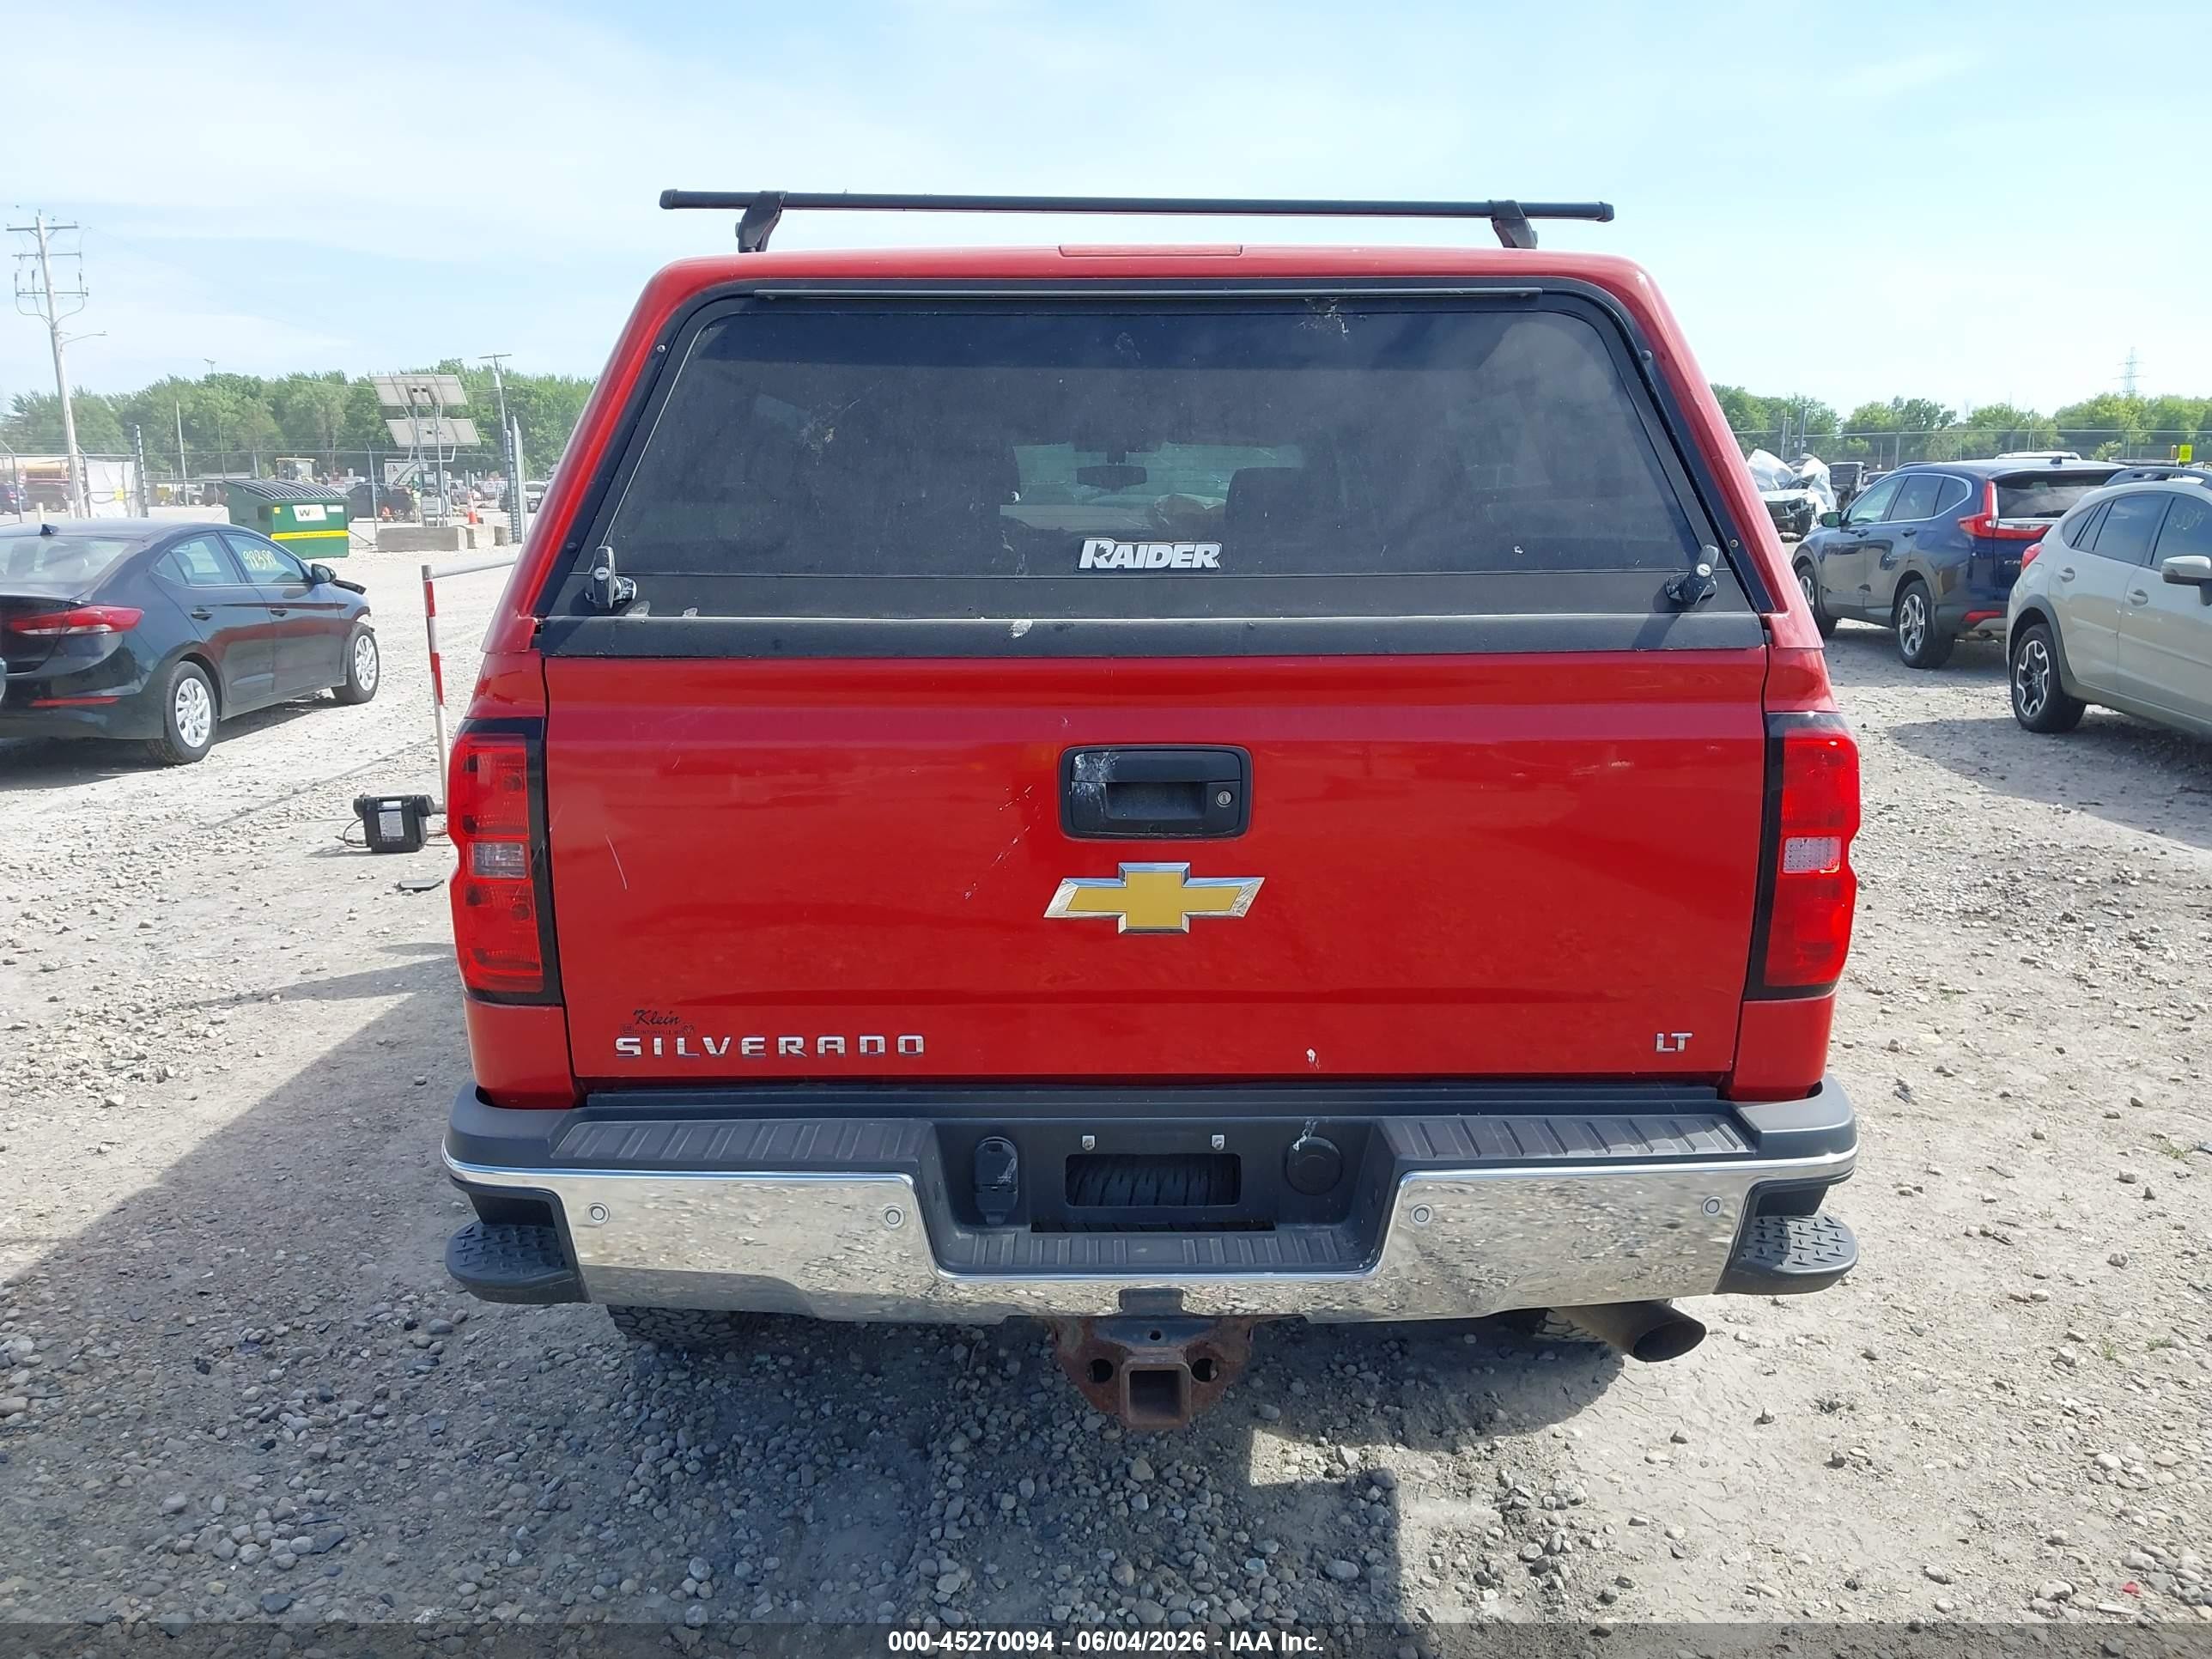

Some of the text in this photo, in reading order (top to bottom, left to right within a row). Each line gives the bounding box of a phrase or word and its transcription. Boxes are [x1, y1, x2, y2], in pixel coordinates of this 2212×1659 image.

[1079, 539, 1220, 569] RAIDER
[633, 1009, 680, 1025] Klein
[615, 1036, 925, 1057] SILVERADO
[1656, 1032, 1693, 1053] LT
